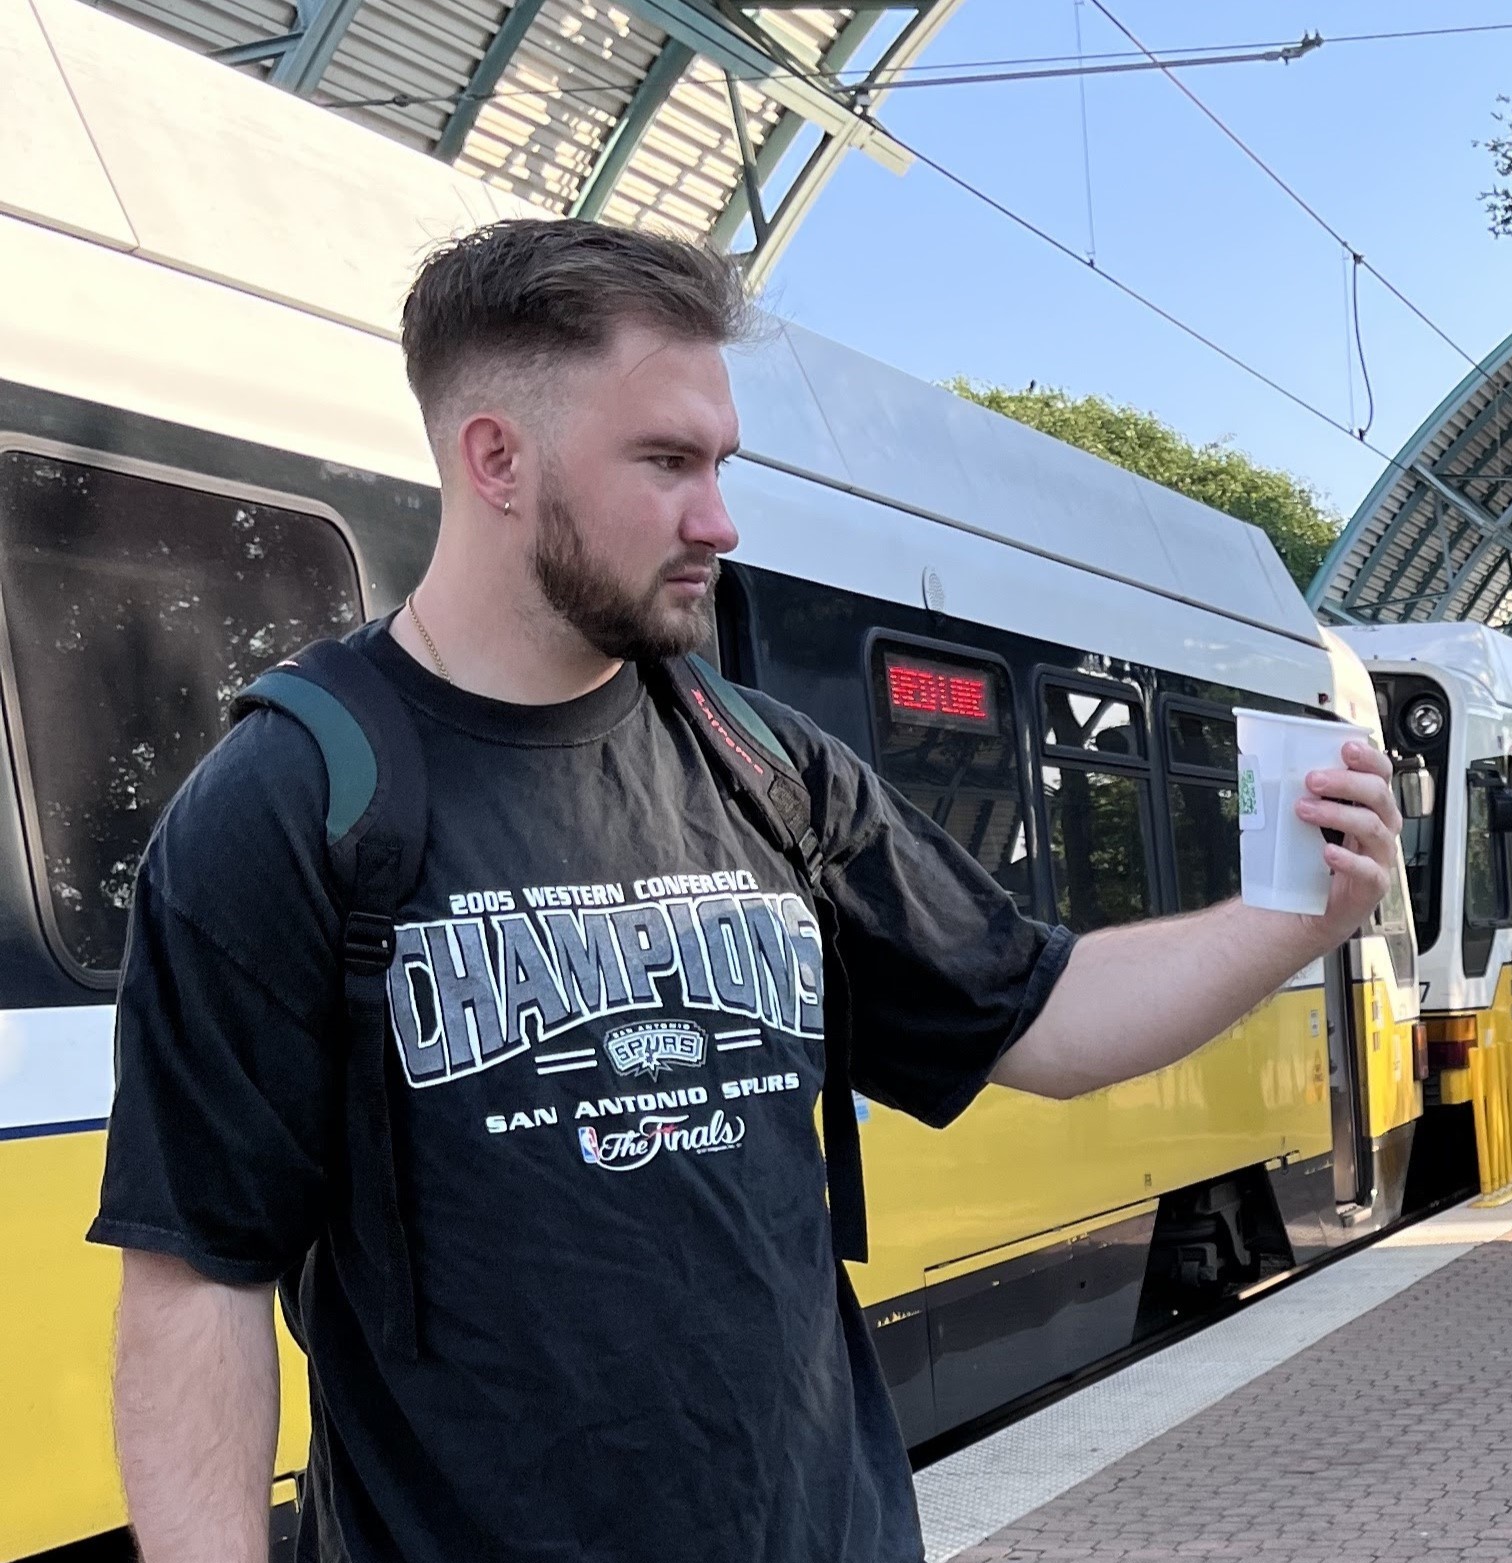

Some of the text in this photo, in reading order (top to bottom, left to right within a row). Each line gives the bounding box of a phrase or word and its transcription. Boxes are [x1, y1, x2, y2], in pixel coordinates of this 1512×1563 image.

[450, 870, 758, 915] 2005 WESTERN CONFERENCE
[387, 892, 825, 1089] CHAMPIONS
[612, 1022, 690, 1039] SAN ANTONIO
[615, 1035, 694, 1061] SPURS
[486, 1072, 799, 1133] SAN ANTONIO SPURS
[599, 1110, 745, 1170] The Finals
